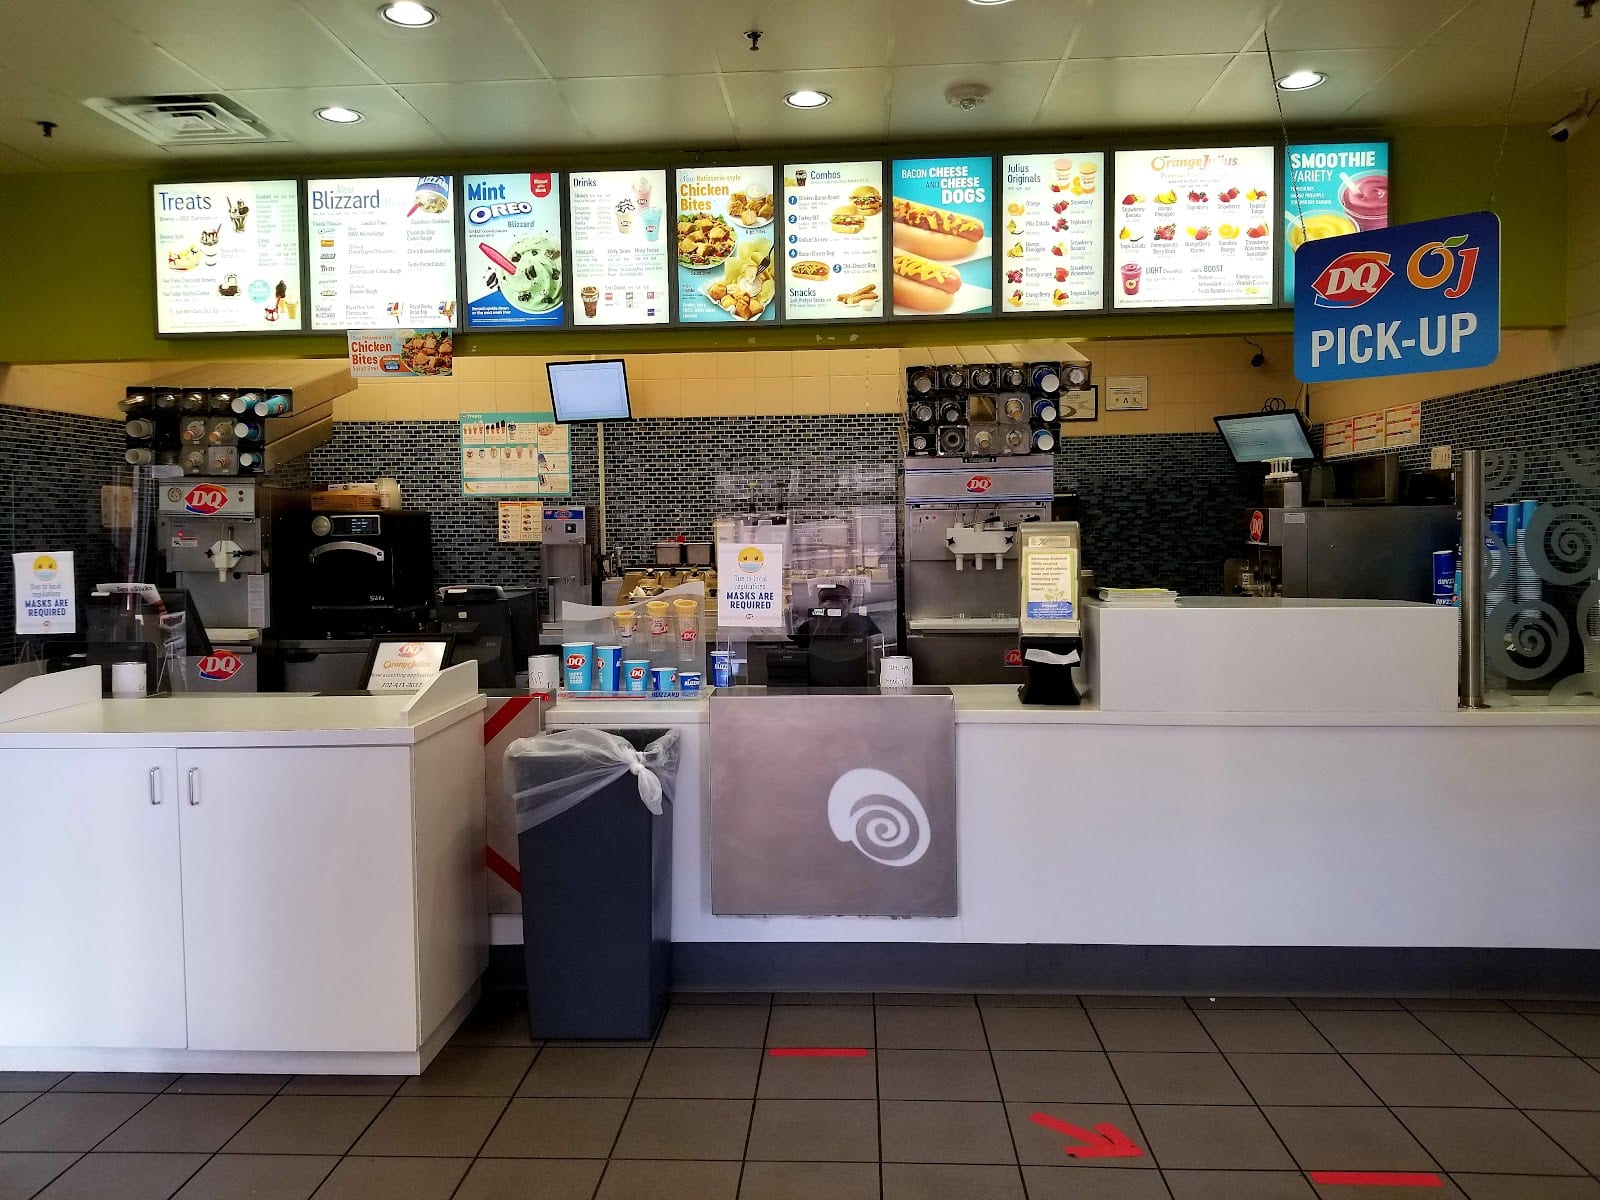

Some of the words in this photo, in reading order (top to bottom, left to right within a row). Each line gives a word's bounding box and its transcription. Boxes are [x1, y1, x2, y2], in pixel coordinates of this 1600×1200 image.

[1150, 156, 1200, 172] Orange
[1290, 151, 1376, 169] SMOOTHIE
[901, 169, 926, 179] BACON
[929, 166, 968, 178] CHEESE
[1007, 164, 1030, 173] Julius
[810, 170, 841, 180] Combos
[1007, 173, 1041, 186] Originals
[1292, 170, 1333, 182] VARIETY
[573, 177, 597, 187] Drinks
[925, 180, 940, 189] AND
[941, 177, 980, 188] CHEESE
[468, 181, 506, 200] Mint
[680, 183, 729, 197] Chicken
[158, 192, 212, 211] Treats
[312, 189, 380, 209] Blizzard
[942, 188, 986, 205] DOGS
[680, 197, 712, 211] Bites
[469, 202, 532, 224] OREO
[507, 220, 535, 228] Blizzard
[1145, 266, 1163, 274] LIGHT
[1204, 264, 1224, 273] BOOST
[1325, 262, 1381, 296] DQ
[1407, 238, 1479, 298] OJ
[789, 288, 816, 297] Snacks
[351, 340, 392, 352] Chicken
[1311, 312, 1478, 368] PICK-UP
[352, 353, 378, 365] Bites
[971, 478, 990, 489] DQ
[191, 491, 222, 509] DQ
[753, 574, 768, 582] local
[49, 582, 62, 590] local
[734, 583, 766, 591] regulations
[32, 591, 62, 599] regulations
[726, 592, 756, 600] MASKS
[758, 592, 774, 600] ARE
[24, 600, 52, 608] MASKS
[54, 599, 69, 607] ARE
[730, 601, 772, 610] REQUIRED
[28, 608, 66, 617] REQUIRED
[205, 656, 236, 674] DQ
[384, 660, 413, 670] Orange
[568, 657, 583, 666] DQ
